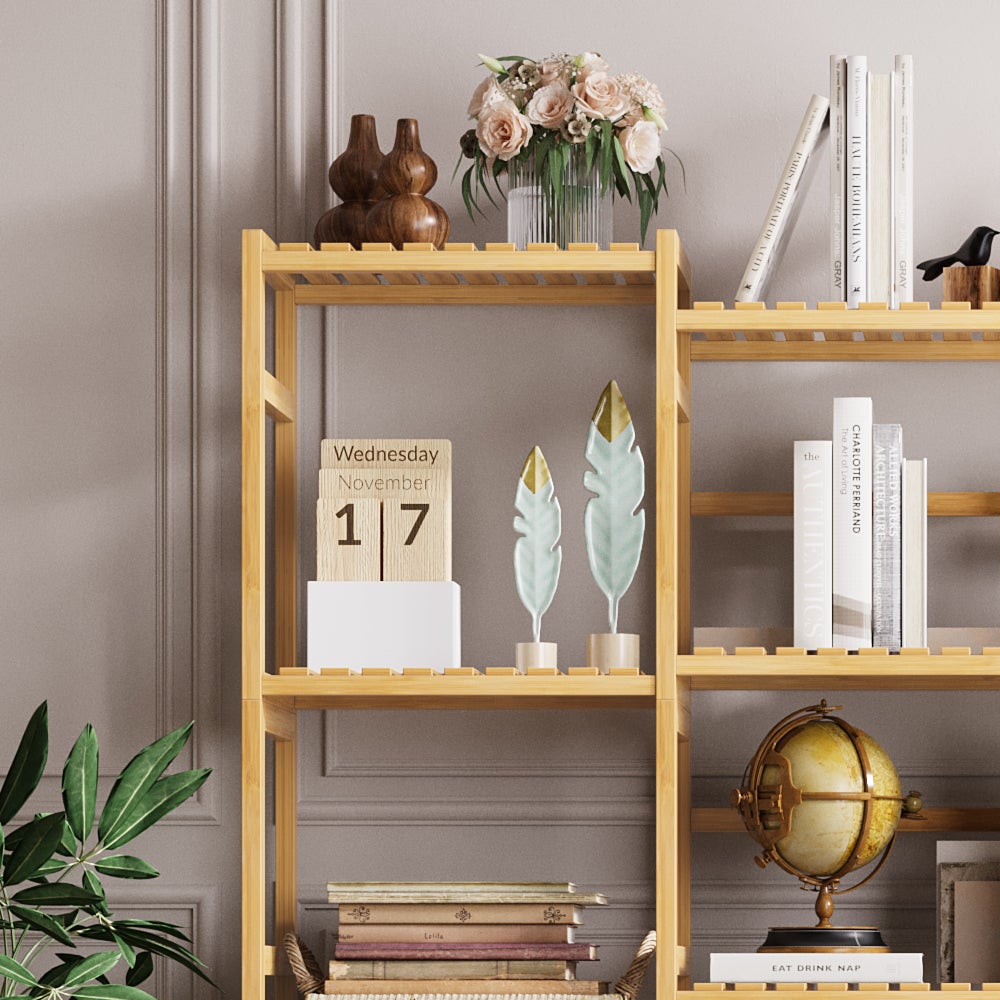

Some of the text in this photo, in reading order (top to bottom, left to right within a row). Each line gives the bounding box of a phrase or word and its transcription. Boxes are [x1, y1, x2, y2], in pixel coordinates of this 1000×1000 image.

[851, 136, 862, 263] HAUTE BOHEMIANS
[833, 260, 842, 290] GRAY
[899, 260, 908, 290] GRAY
[842, 428, 850, 444] The
[333, 445, 439, 465] Wednesday
[803, 451, 820, 462] the
[842, 446, 850, 459] Art
[338, 474, 431, 491] November
[840, 471, 850, 495] Living
[852, 424, 861, 534] CHARLOTTE PERRIAND
[889, 445, 899, 538] ALLIED WORKS
